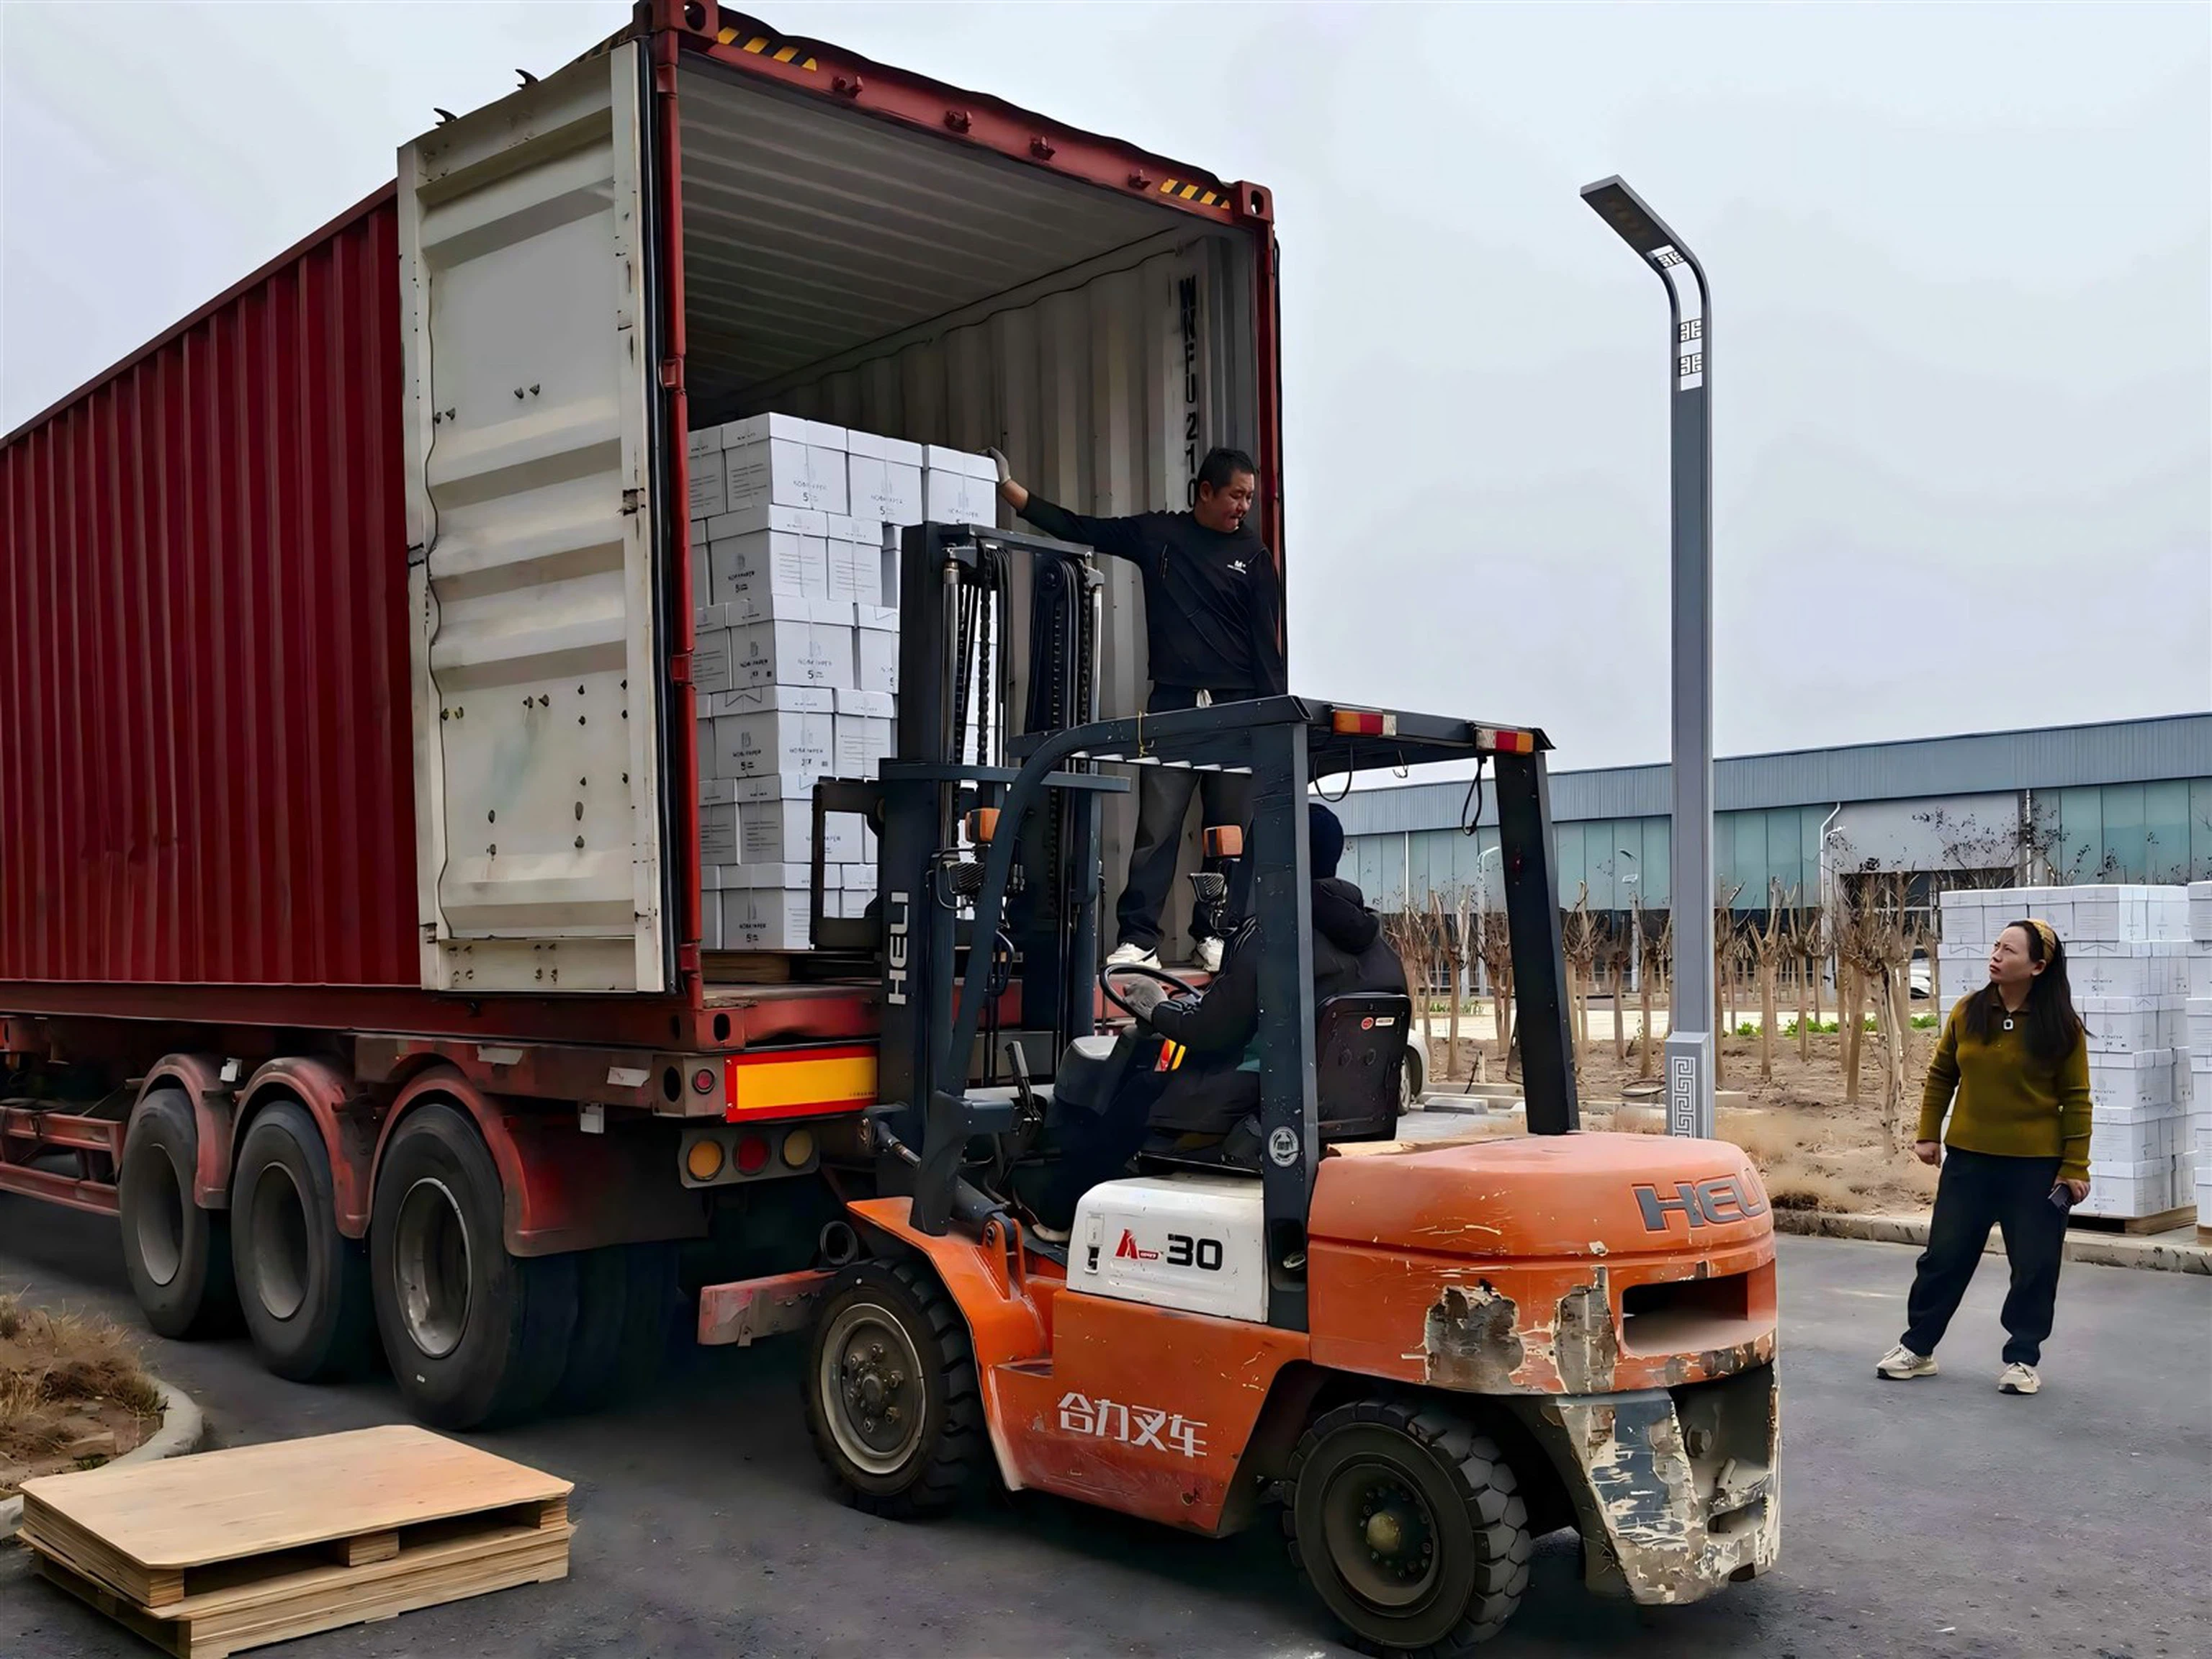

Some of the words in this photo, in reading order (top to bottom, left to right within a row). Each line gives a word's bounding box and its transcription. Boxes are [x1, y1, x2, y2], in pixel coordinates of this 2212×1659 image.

[889, 892, 909, 1004] HELI
[1166, 1233, 1223, 1271] 30
[1057, 1391, 1208, 1457] 合力叉车
